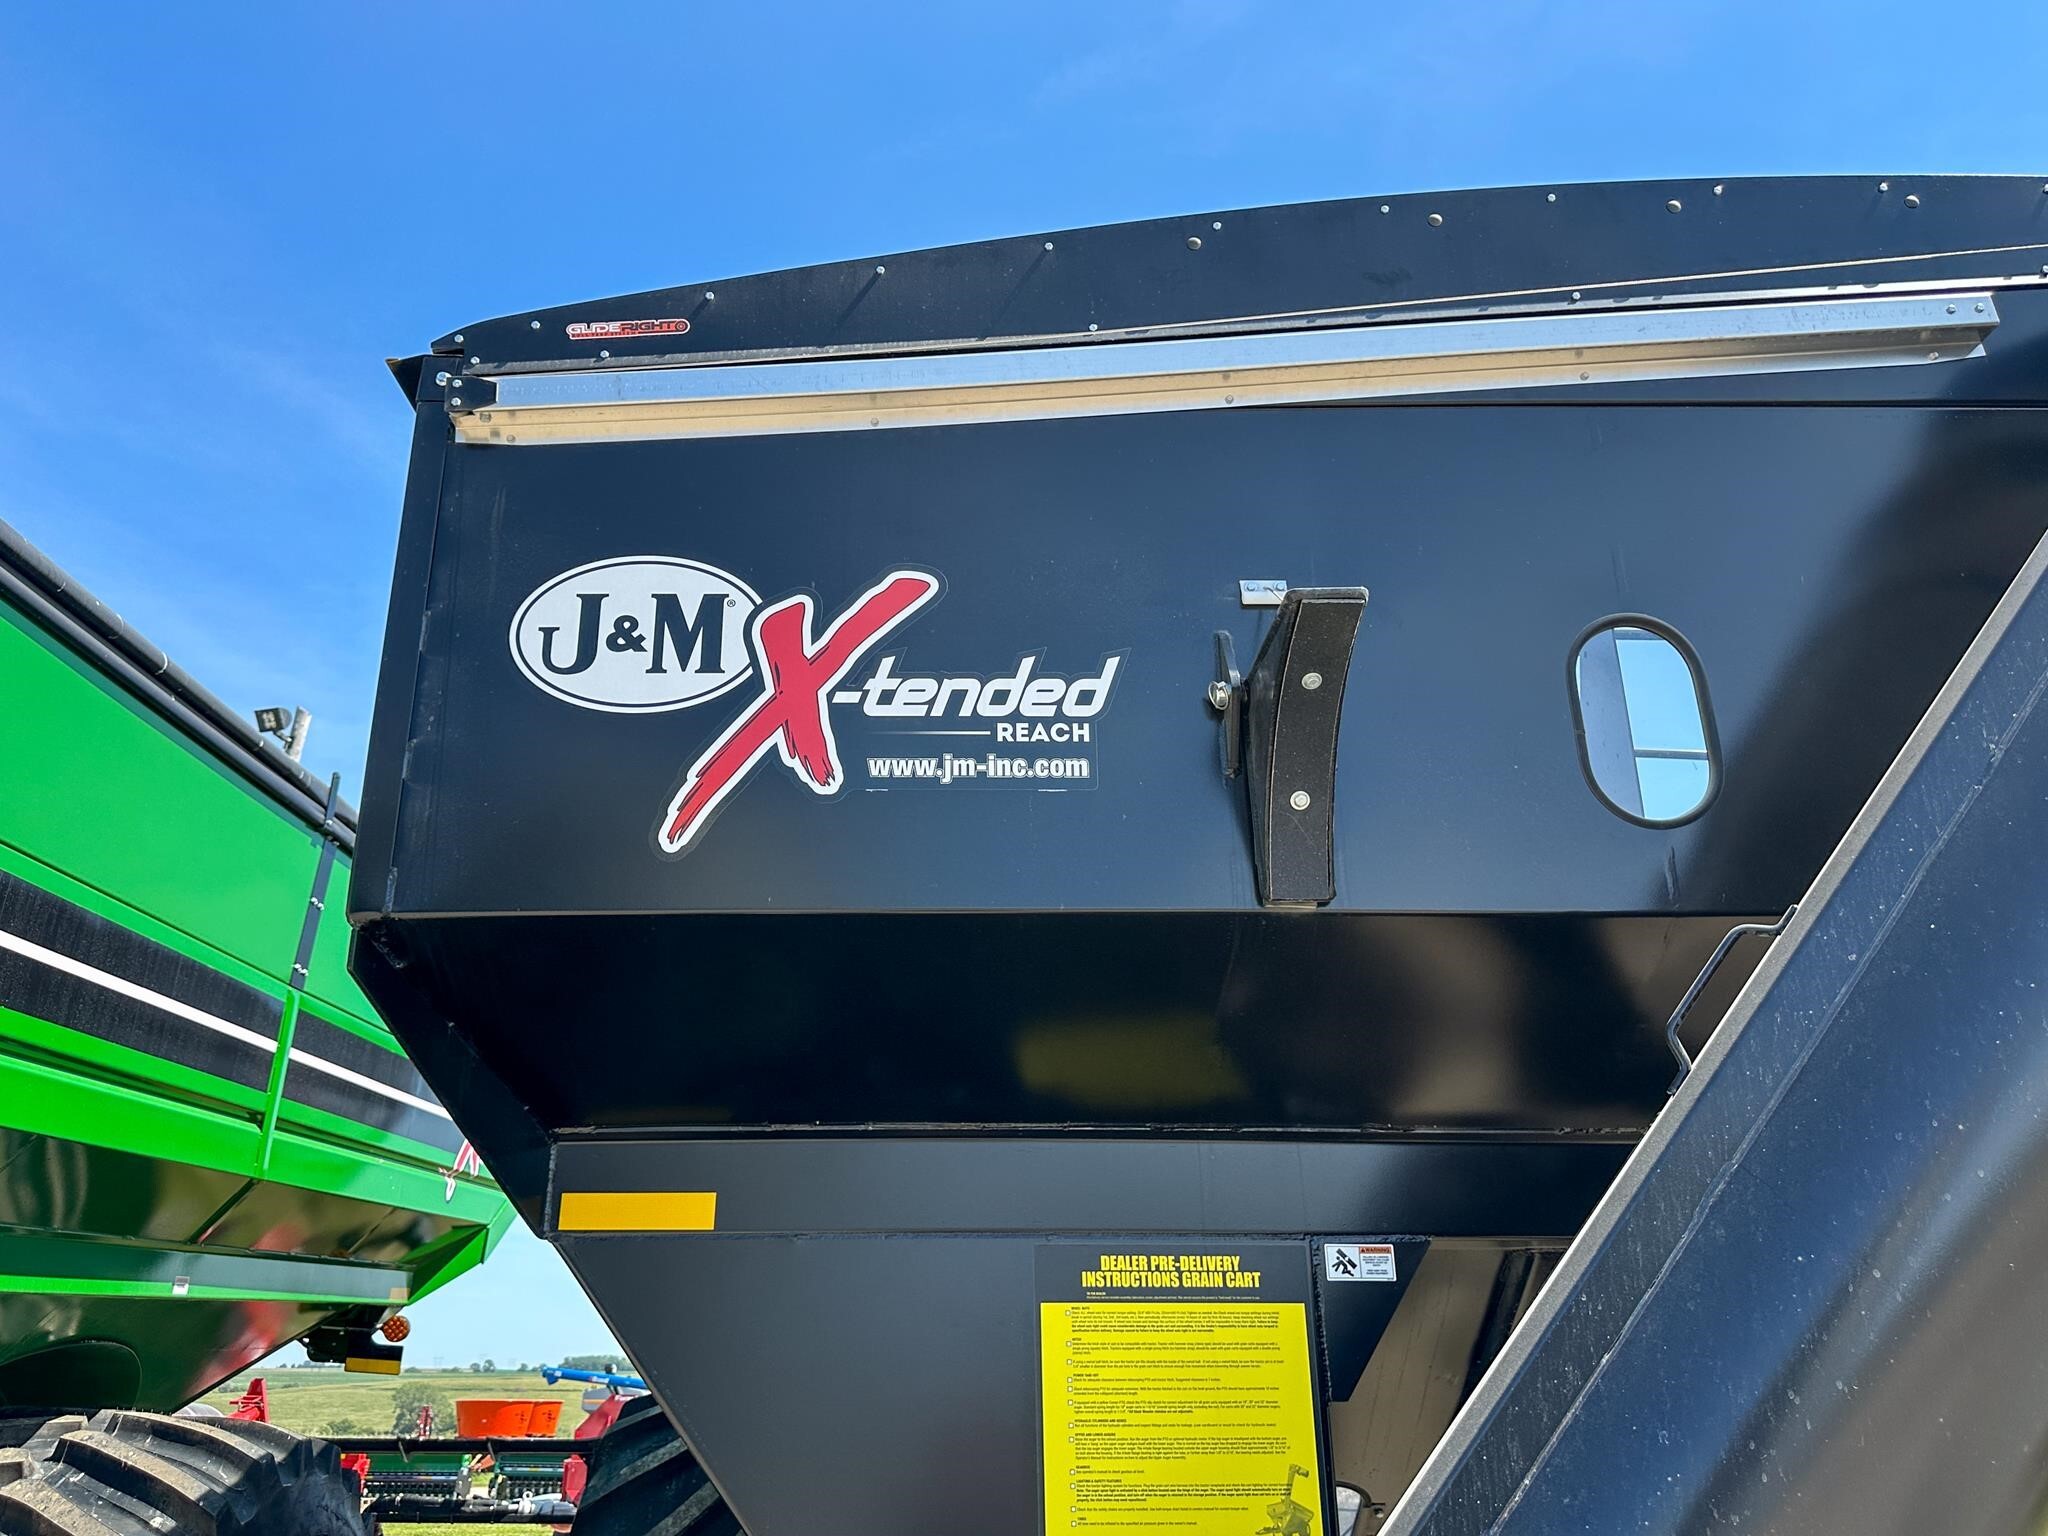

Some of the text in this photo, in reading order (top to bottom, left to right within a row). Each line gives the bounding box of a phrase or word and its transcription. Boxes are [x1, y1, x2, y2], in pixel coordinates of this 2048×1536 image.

[997, 723, 1091, 743] REACH
[866, 753, 1090, 785] www.jm-inc.com
[1100, 1255, 1240, 1271] DEALER PRE-DELIVERY
[1081, 1271, 1261, 1288] INSTRUCTIONS GRAIN CART
